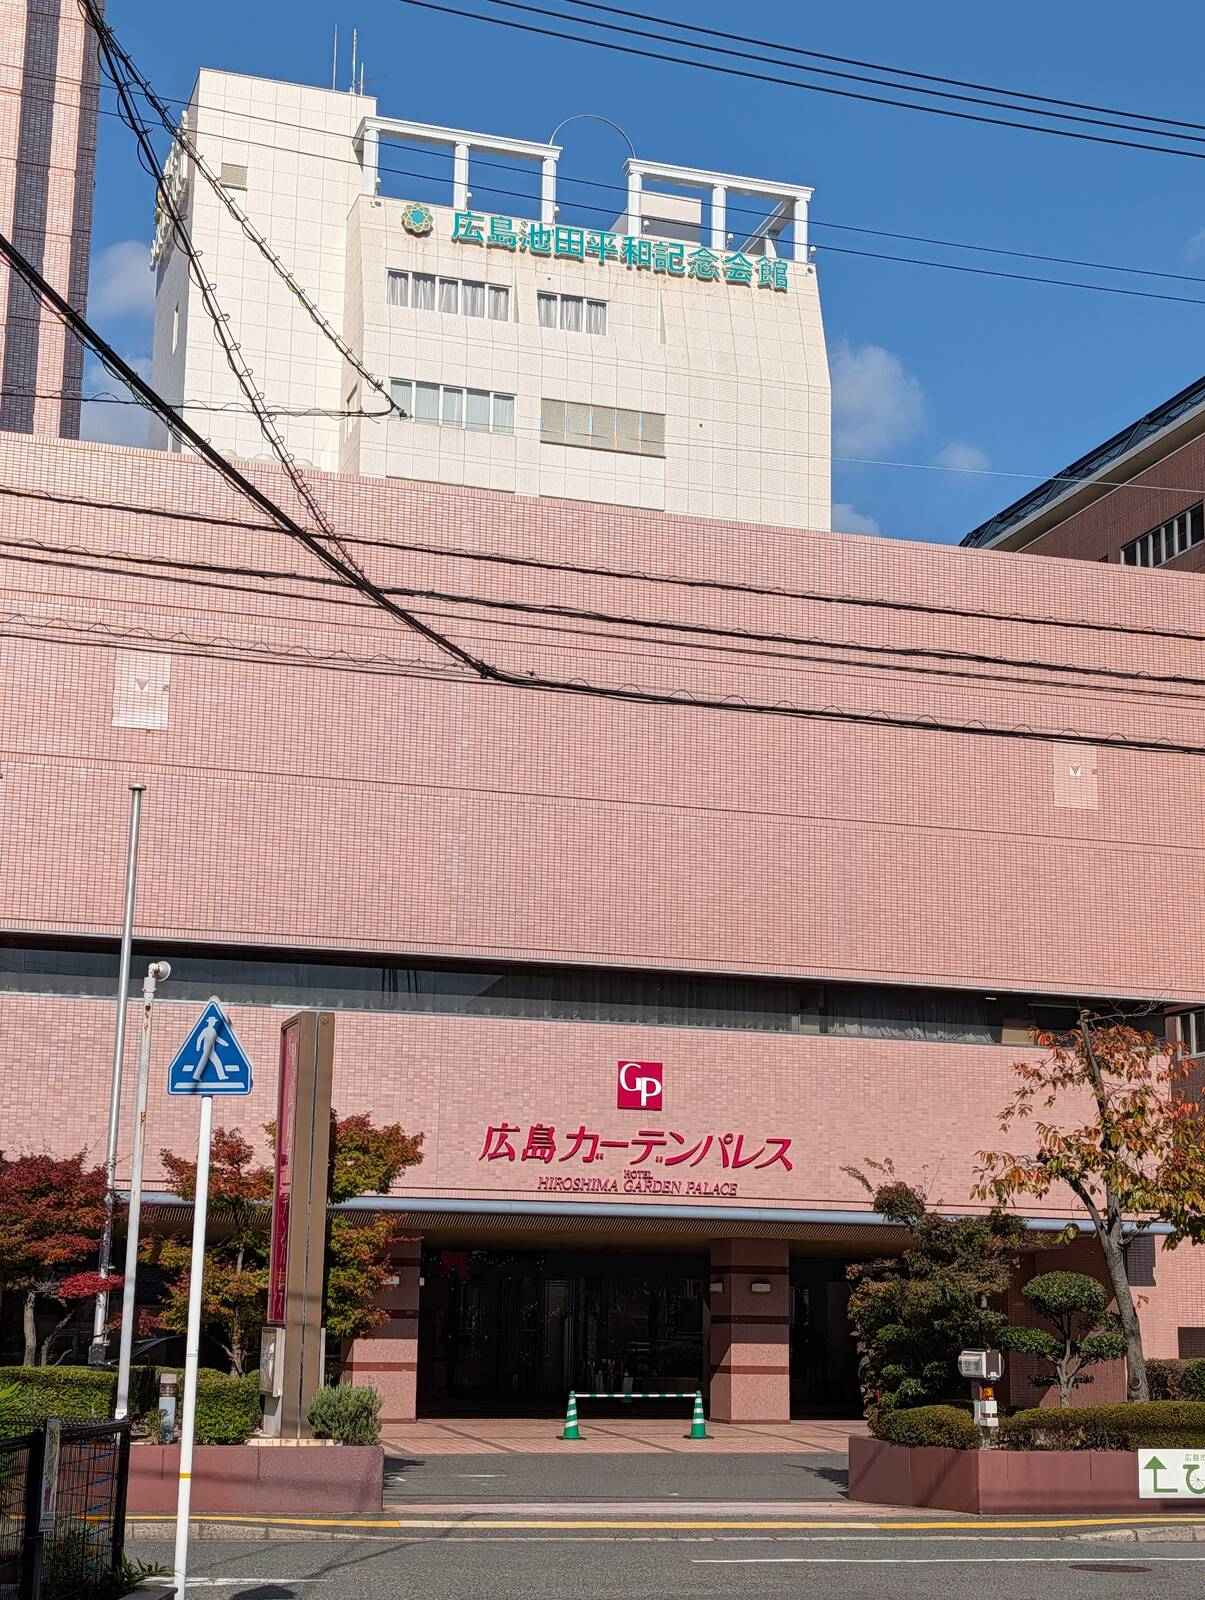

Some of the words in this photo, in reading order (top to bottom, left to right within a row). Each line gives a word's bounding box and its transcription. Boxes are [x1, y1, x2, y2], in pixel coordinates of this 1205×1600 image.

[451, 210, 789, 291] 広島池田平和記念会館
[619, 1062, 662, 1107] GP
[478, 1121, 793, 1172] 広島ガーデンパレス
[537, 1176, 618, 1192] HIROSHIMA
[623, 1180, 682, 1194] GARDEN
[685, 1181, 738, 1196] PALACE
[623, 1169, 653, 1180] HOTEL
